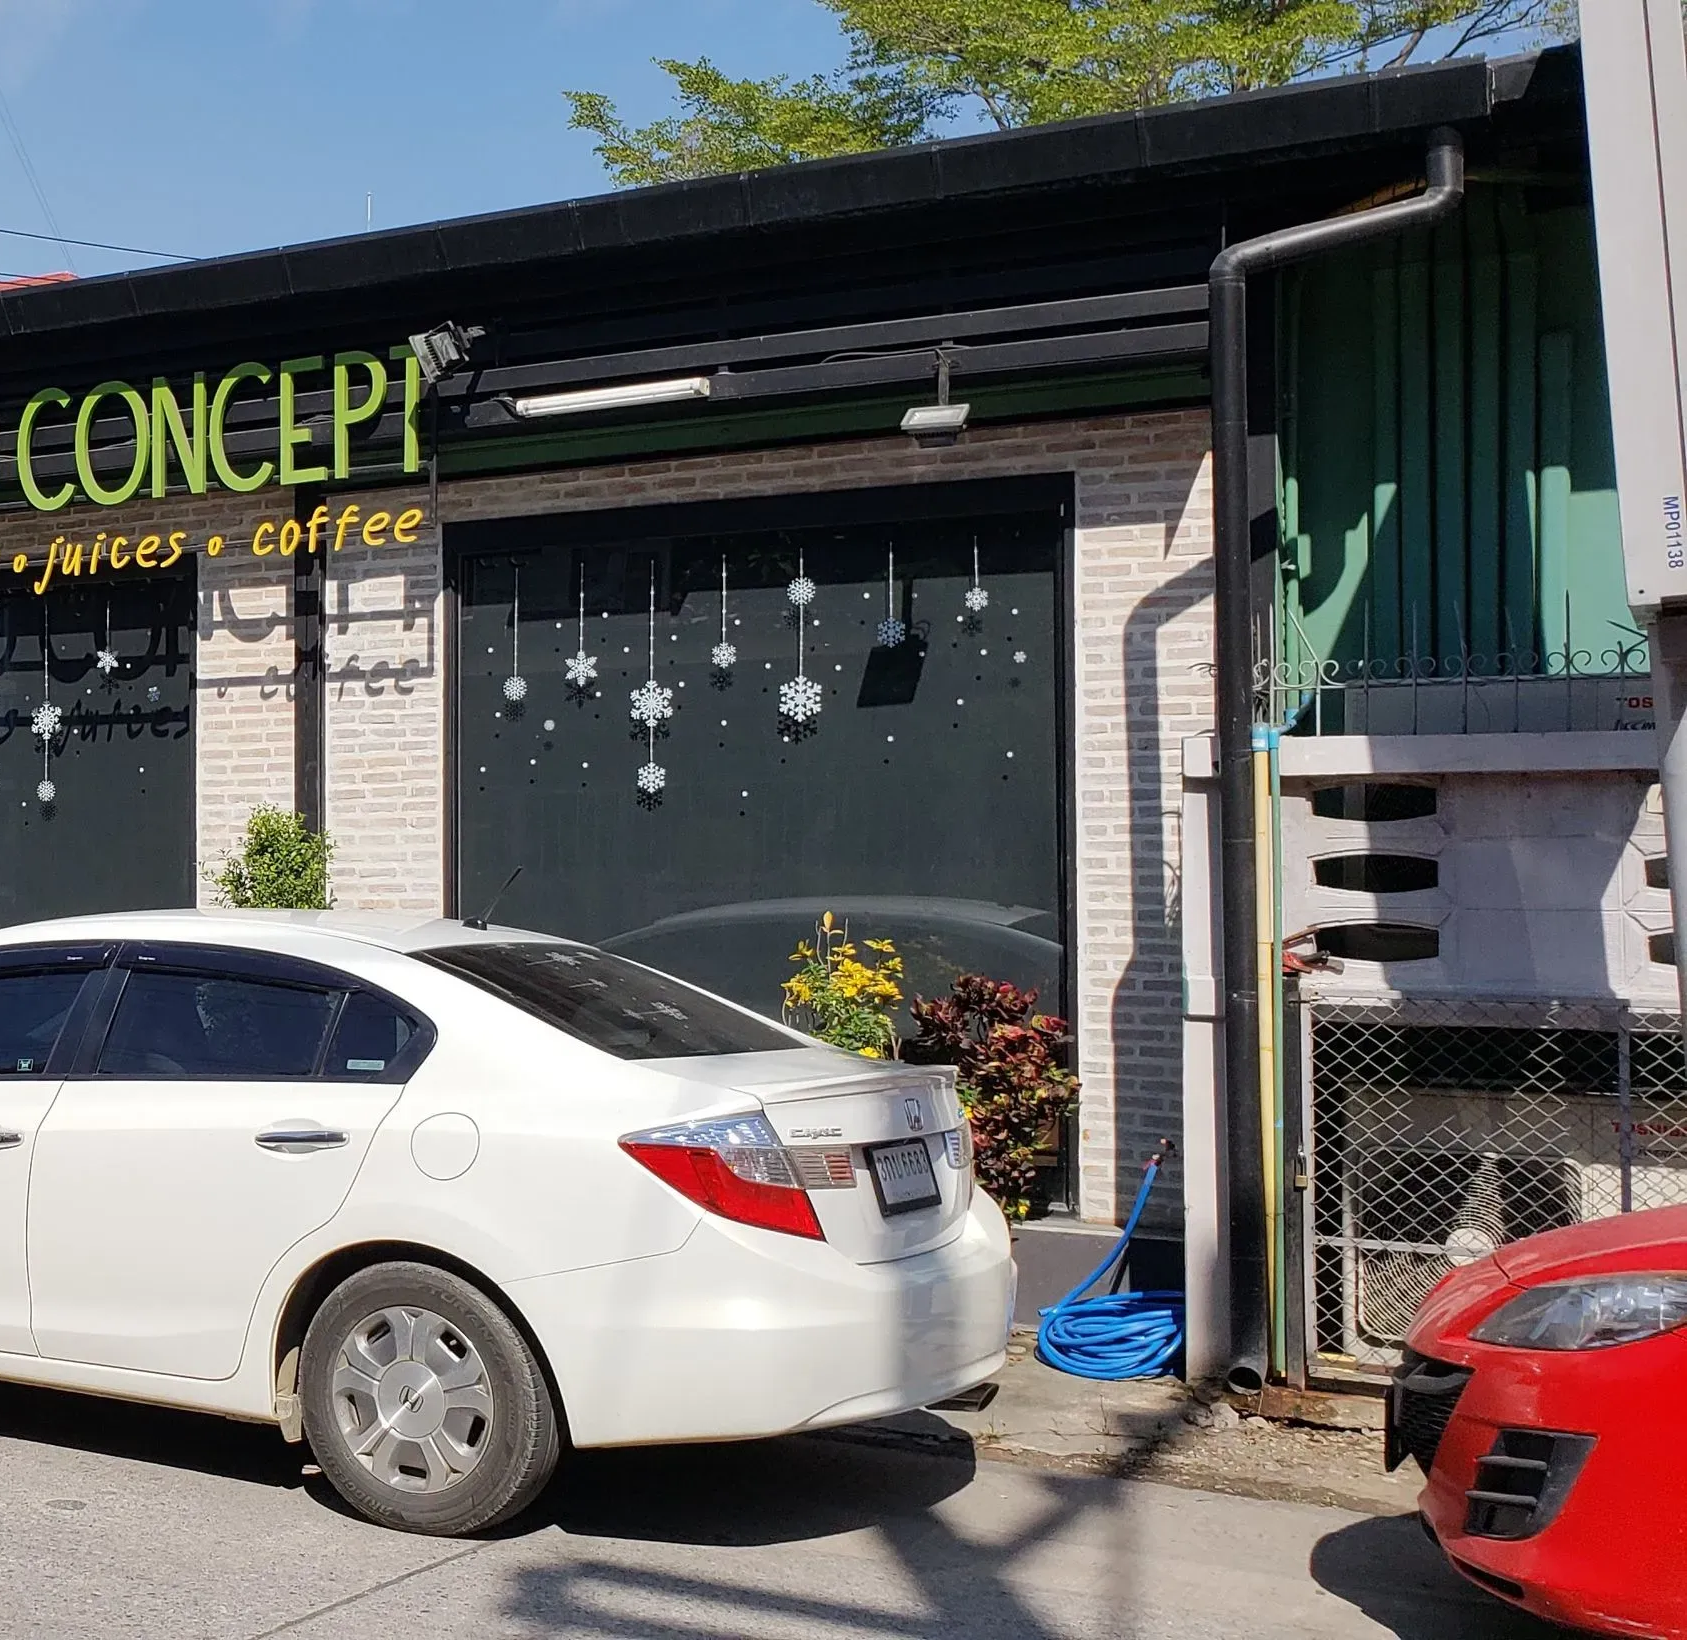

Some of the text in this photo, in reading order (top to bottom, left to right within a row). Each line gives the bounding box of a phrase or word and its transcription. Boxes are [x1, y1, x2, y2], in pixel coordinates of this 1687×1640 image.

[17, 345, 422, 511] CONCEPT
[33, 531, 187, 595] juices
[253, 505, 423, 556] coffee
[1663, 496, 1684, 568] MP01138
[1611, 1121, 1687, 1137] TSHIB
